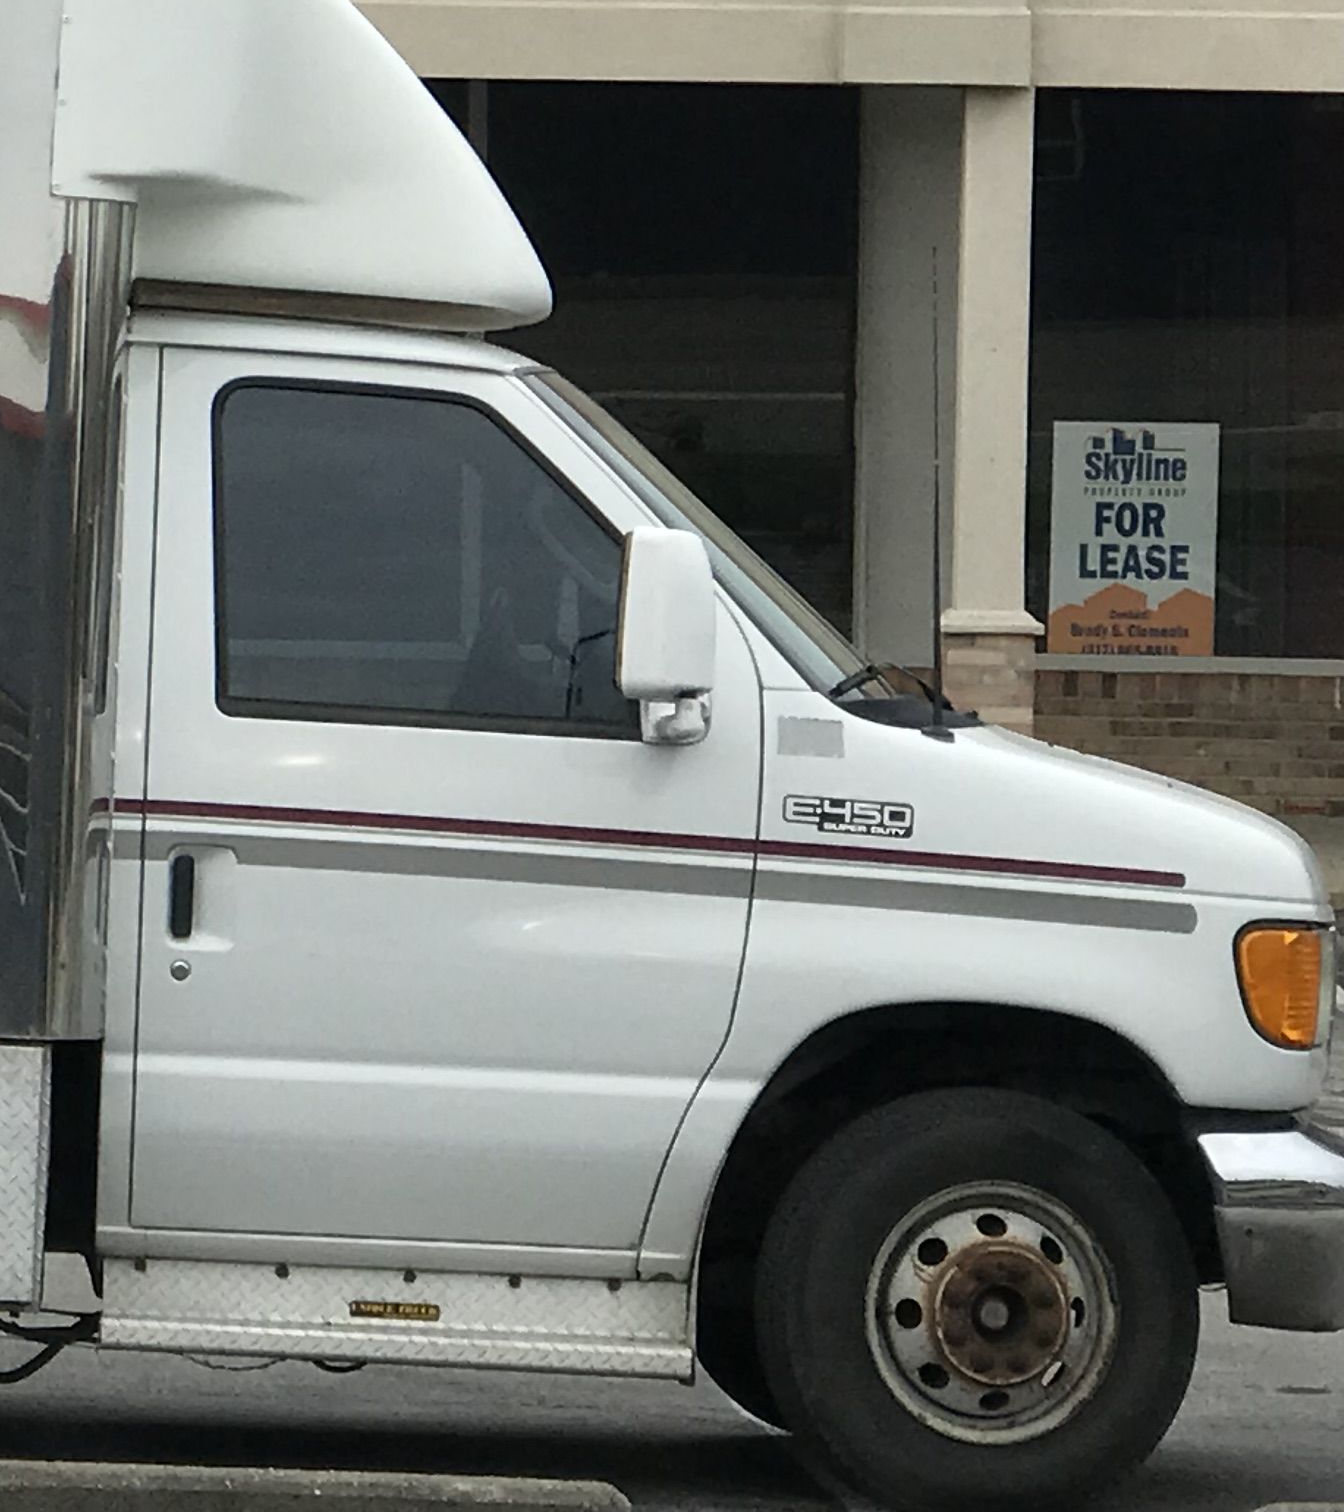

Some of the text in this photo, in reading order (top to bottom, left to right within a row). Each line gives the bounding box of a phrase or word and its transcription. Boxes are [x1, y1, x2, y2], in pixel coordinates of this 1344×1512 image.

[1083, 452, 1187, 485] Skyline
[1094, 502, 1166, 538] FOR
[1078, 544, 1190, 580] LEASE
[823, 822, 907, 836] SUPER DUTY
